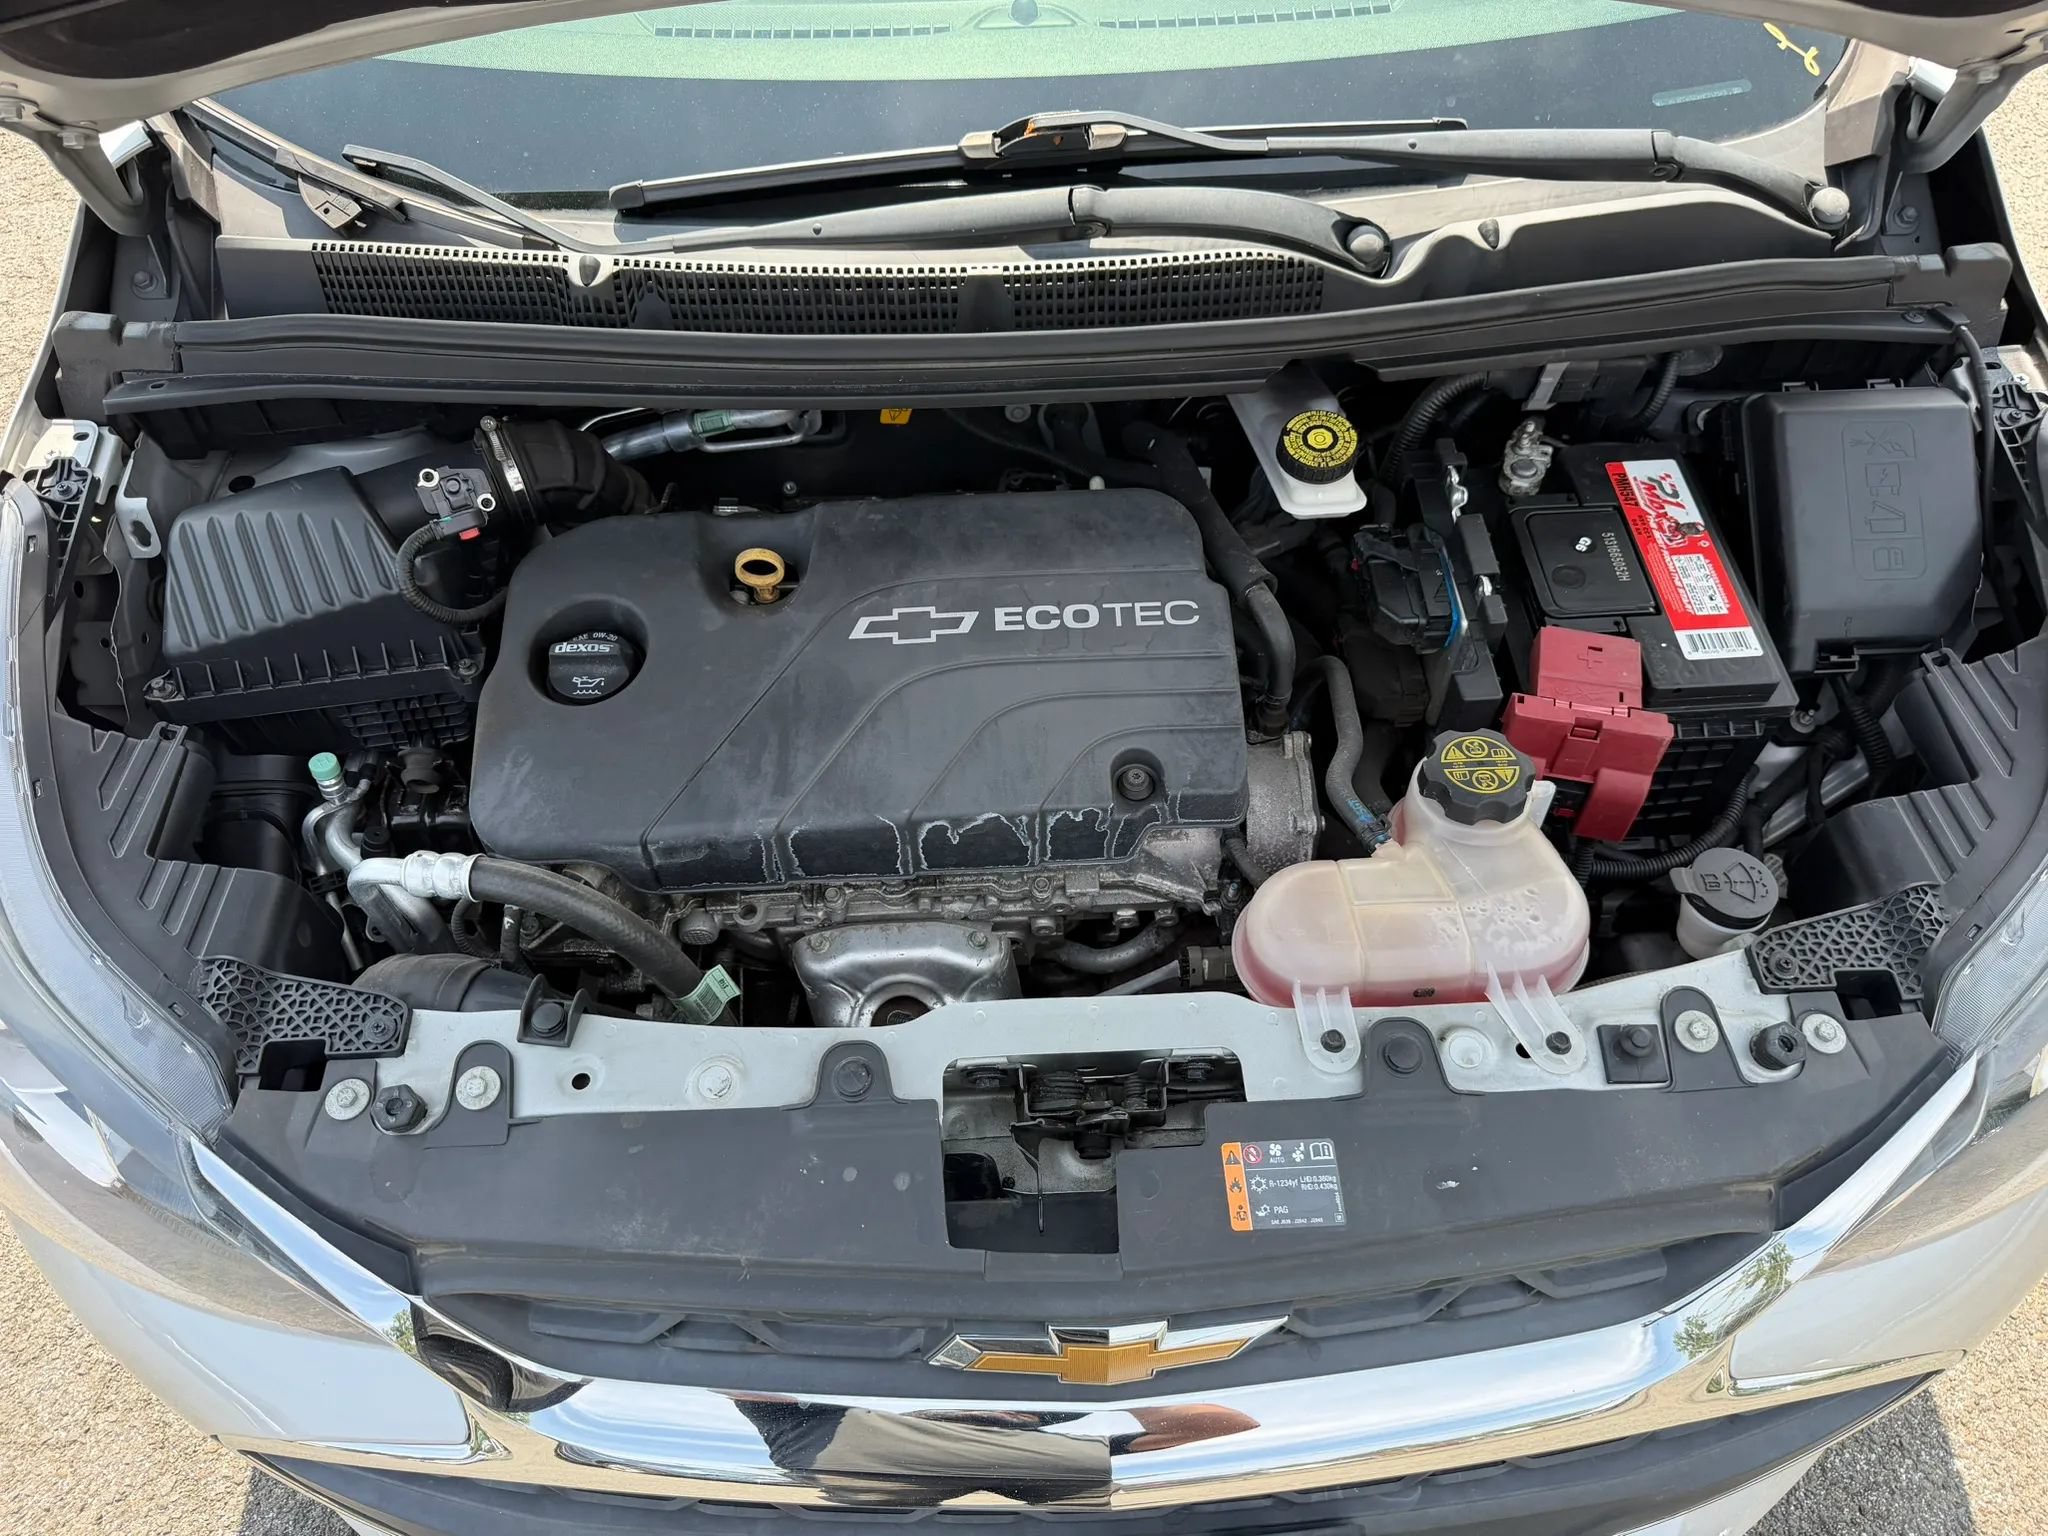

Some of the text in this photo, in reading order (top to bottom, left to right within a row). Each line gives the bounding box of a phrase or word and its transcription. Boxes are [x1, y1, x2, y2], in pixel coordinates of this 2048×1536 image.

[1612, 472, 1639, 507] PMH547
[1575, 536, 1592, 552] G6
[1601, 531, 1631, 583] 5131665052H
[1659, 548, 1677, 572] FROM
[1669, 572, 1683, 587] THE
[1675, 587, 1695, 615] START
[994, 600, 1200, 631] ECOTEC
[592, 632, 618, 641] 0W-20
[554, 641, 611, 653] dexos
[1269, 1156, 1286, 1164] AUTO
[1269, 1178, 1299, 1188] R-1234yf
[1273, 1205, 1289, 1214] PAG
